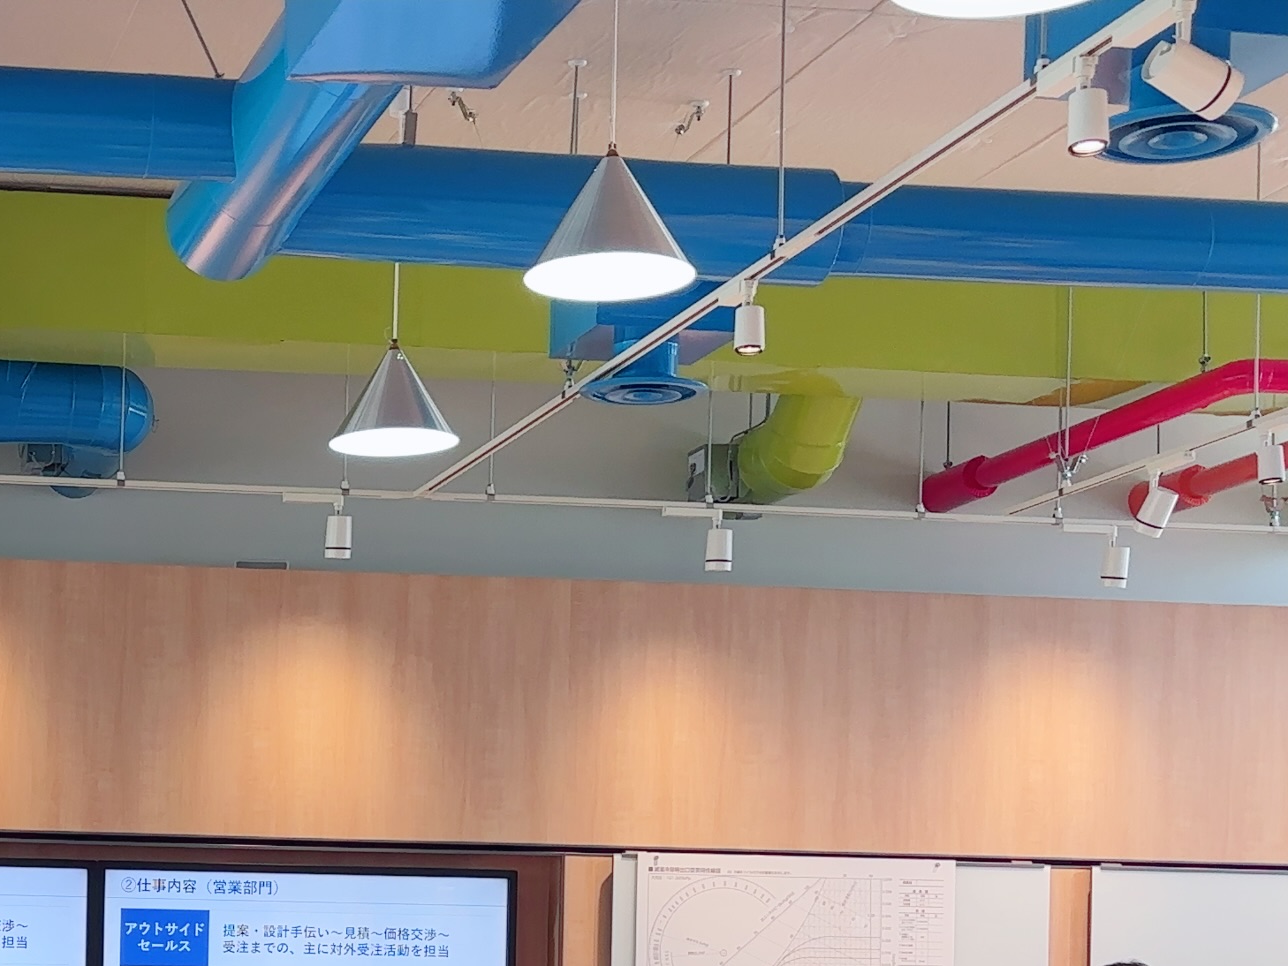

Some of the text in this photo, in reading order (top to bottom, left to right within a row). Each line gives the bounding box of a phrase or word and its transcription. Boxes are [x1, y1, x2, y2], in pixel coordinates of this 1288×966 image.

[125, 922, 204, 936] アウトサイド
[137, 939, 191, 952] セールス
